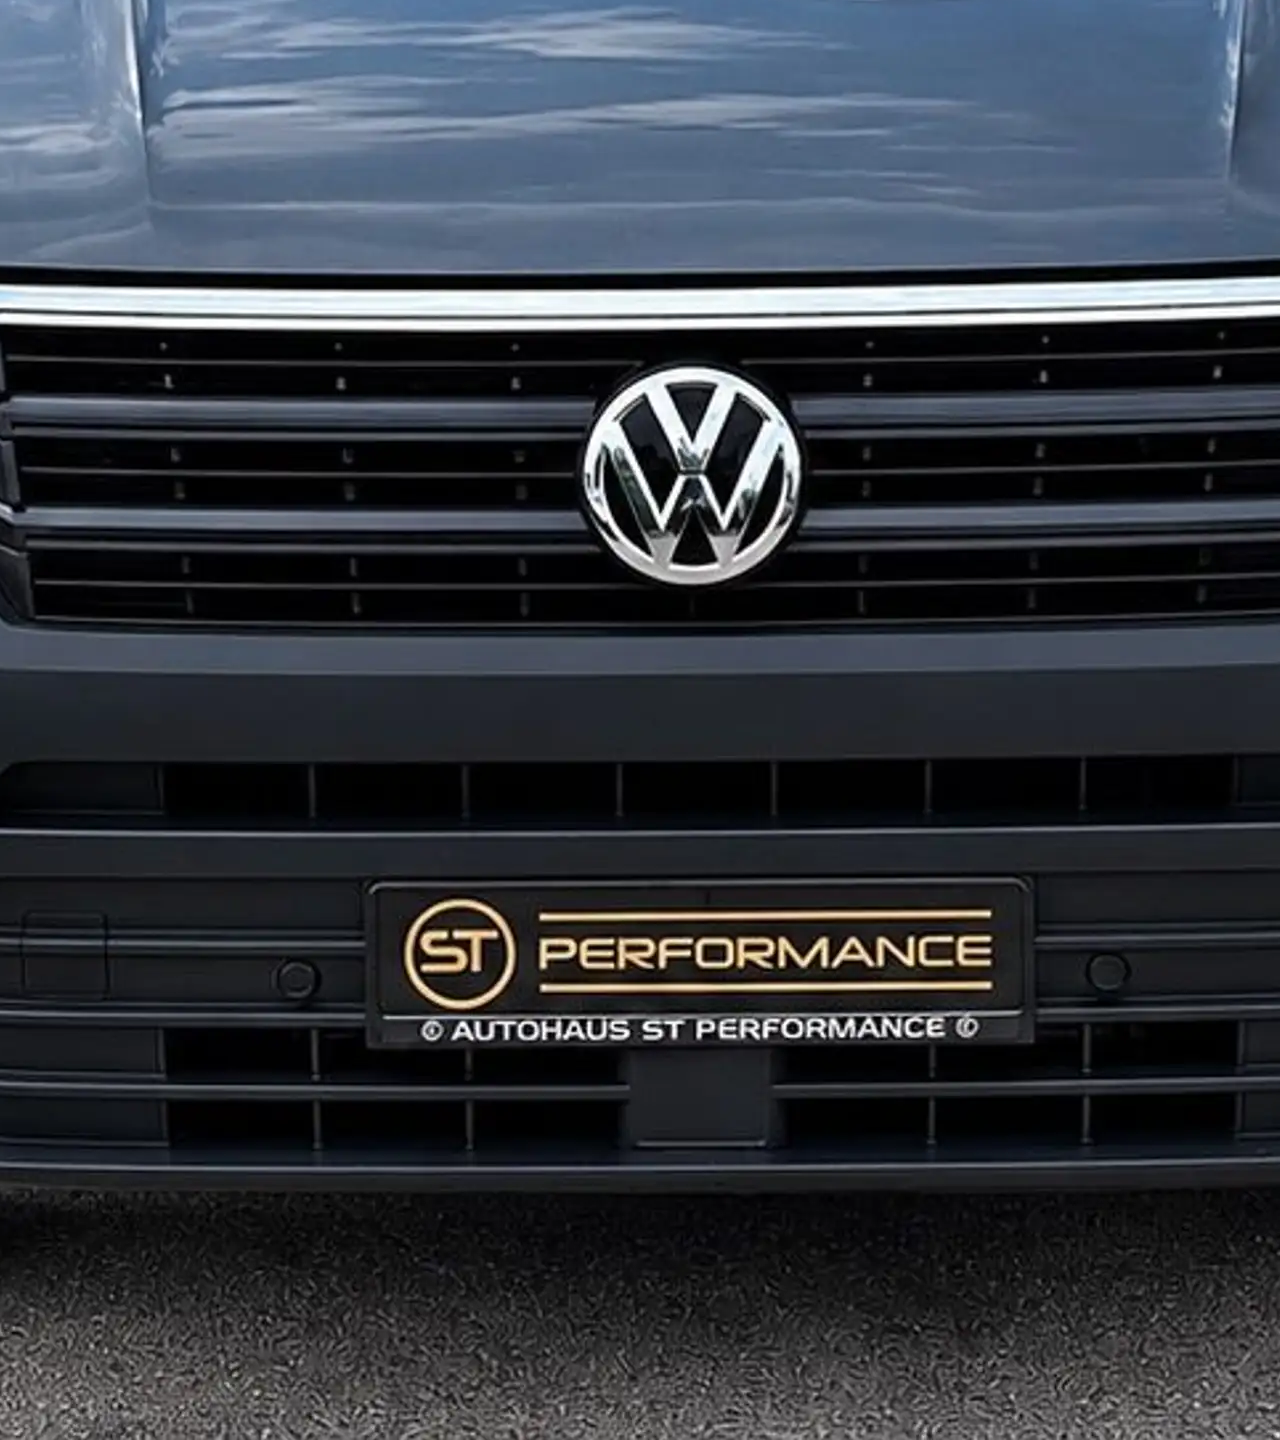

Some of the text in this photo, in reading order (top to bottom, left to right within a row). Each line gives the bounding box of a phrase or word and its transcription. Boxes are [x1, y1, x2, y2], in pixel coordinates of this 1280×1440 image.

[586, 368, 800, 584] VW
[420, 929, 992, 973] ST PERFORMANCE
[451, 1016, 946, 1042] AUTOHAUS ST PERFORMANCE
